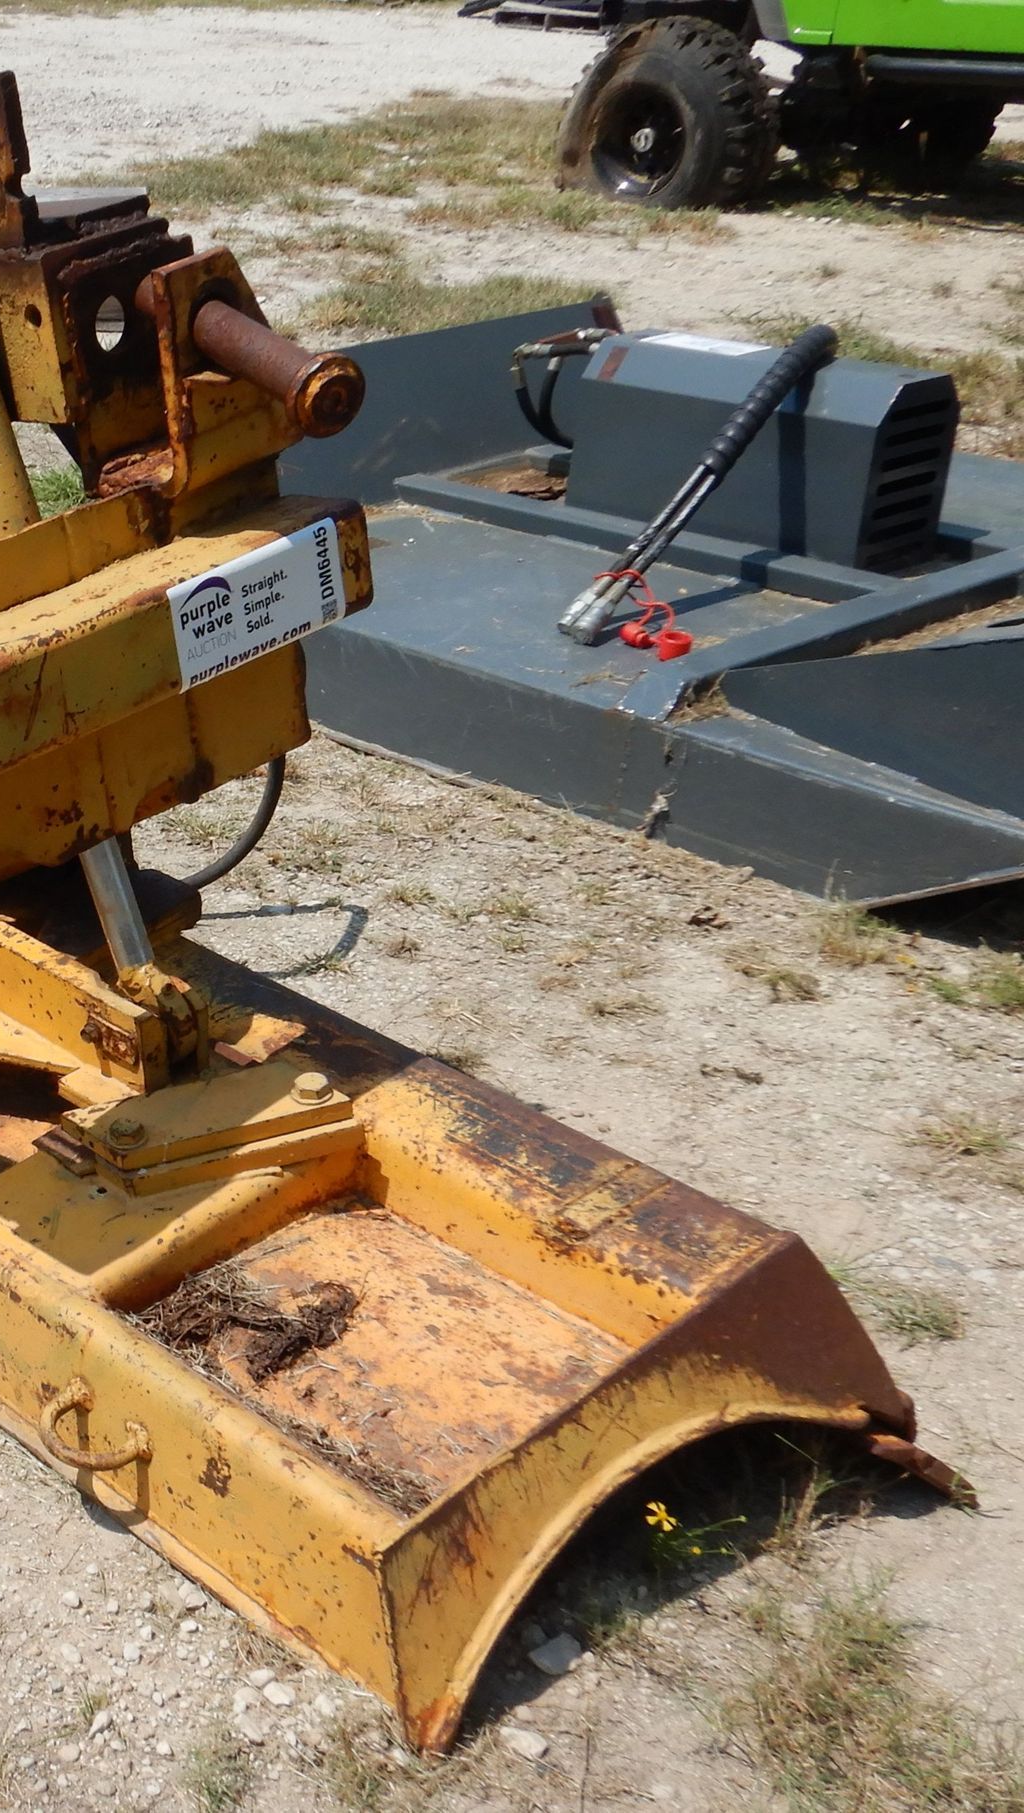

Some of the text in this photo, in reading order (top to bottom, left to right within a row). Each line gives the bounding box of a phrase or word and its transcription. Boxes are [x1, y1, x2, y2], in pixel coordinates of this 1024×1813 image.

[313, 526, 335, 600] DM6445
[241, 569, 288, 598] Straight.
[180, 592, 231, 630] purple
[243, 591, 285, 617] Simple.
[192, 610, 233, 639] wave
[246, 612, 274, 634] Sold.
[187, 630, 237, 661] AUCTION
[189, 620, 312, 687] purplewave.com
